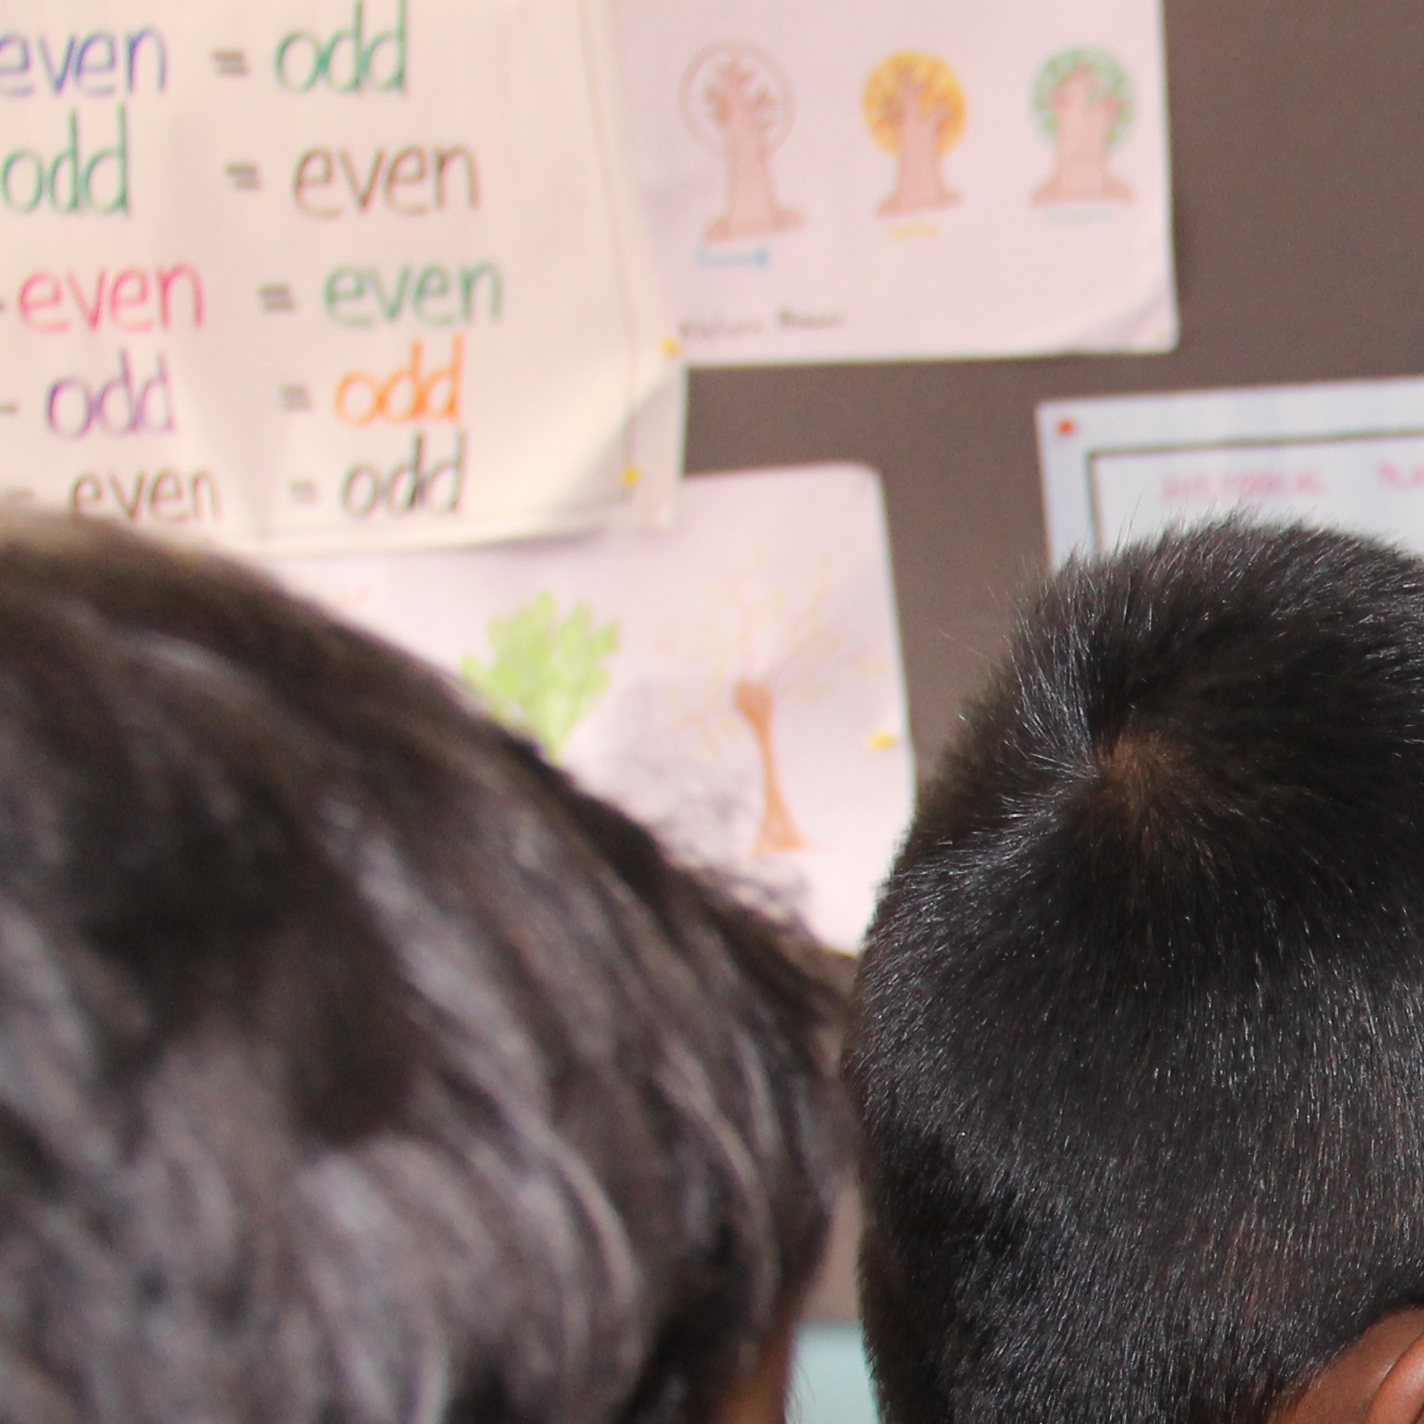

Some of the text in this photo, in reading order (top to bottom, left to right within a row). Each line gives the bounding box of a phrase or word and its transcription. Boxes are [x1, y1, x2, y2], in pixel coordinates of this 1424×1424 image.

[0, 26, 168, 97] even
[273, 0, 409, 95] odd
[0, 101, 131, 217] odd
[292, 142, 480, 220] even
[17, 262, 206, 334] even
[321, 259, 503, 328] even
[45, 345, 178, 440] odd
[333, 330, 466, 427] odd
[70, 465, 224, 523] even
[340, 429, 467, 519] odd
